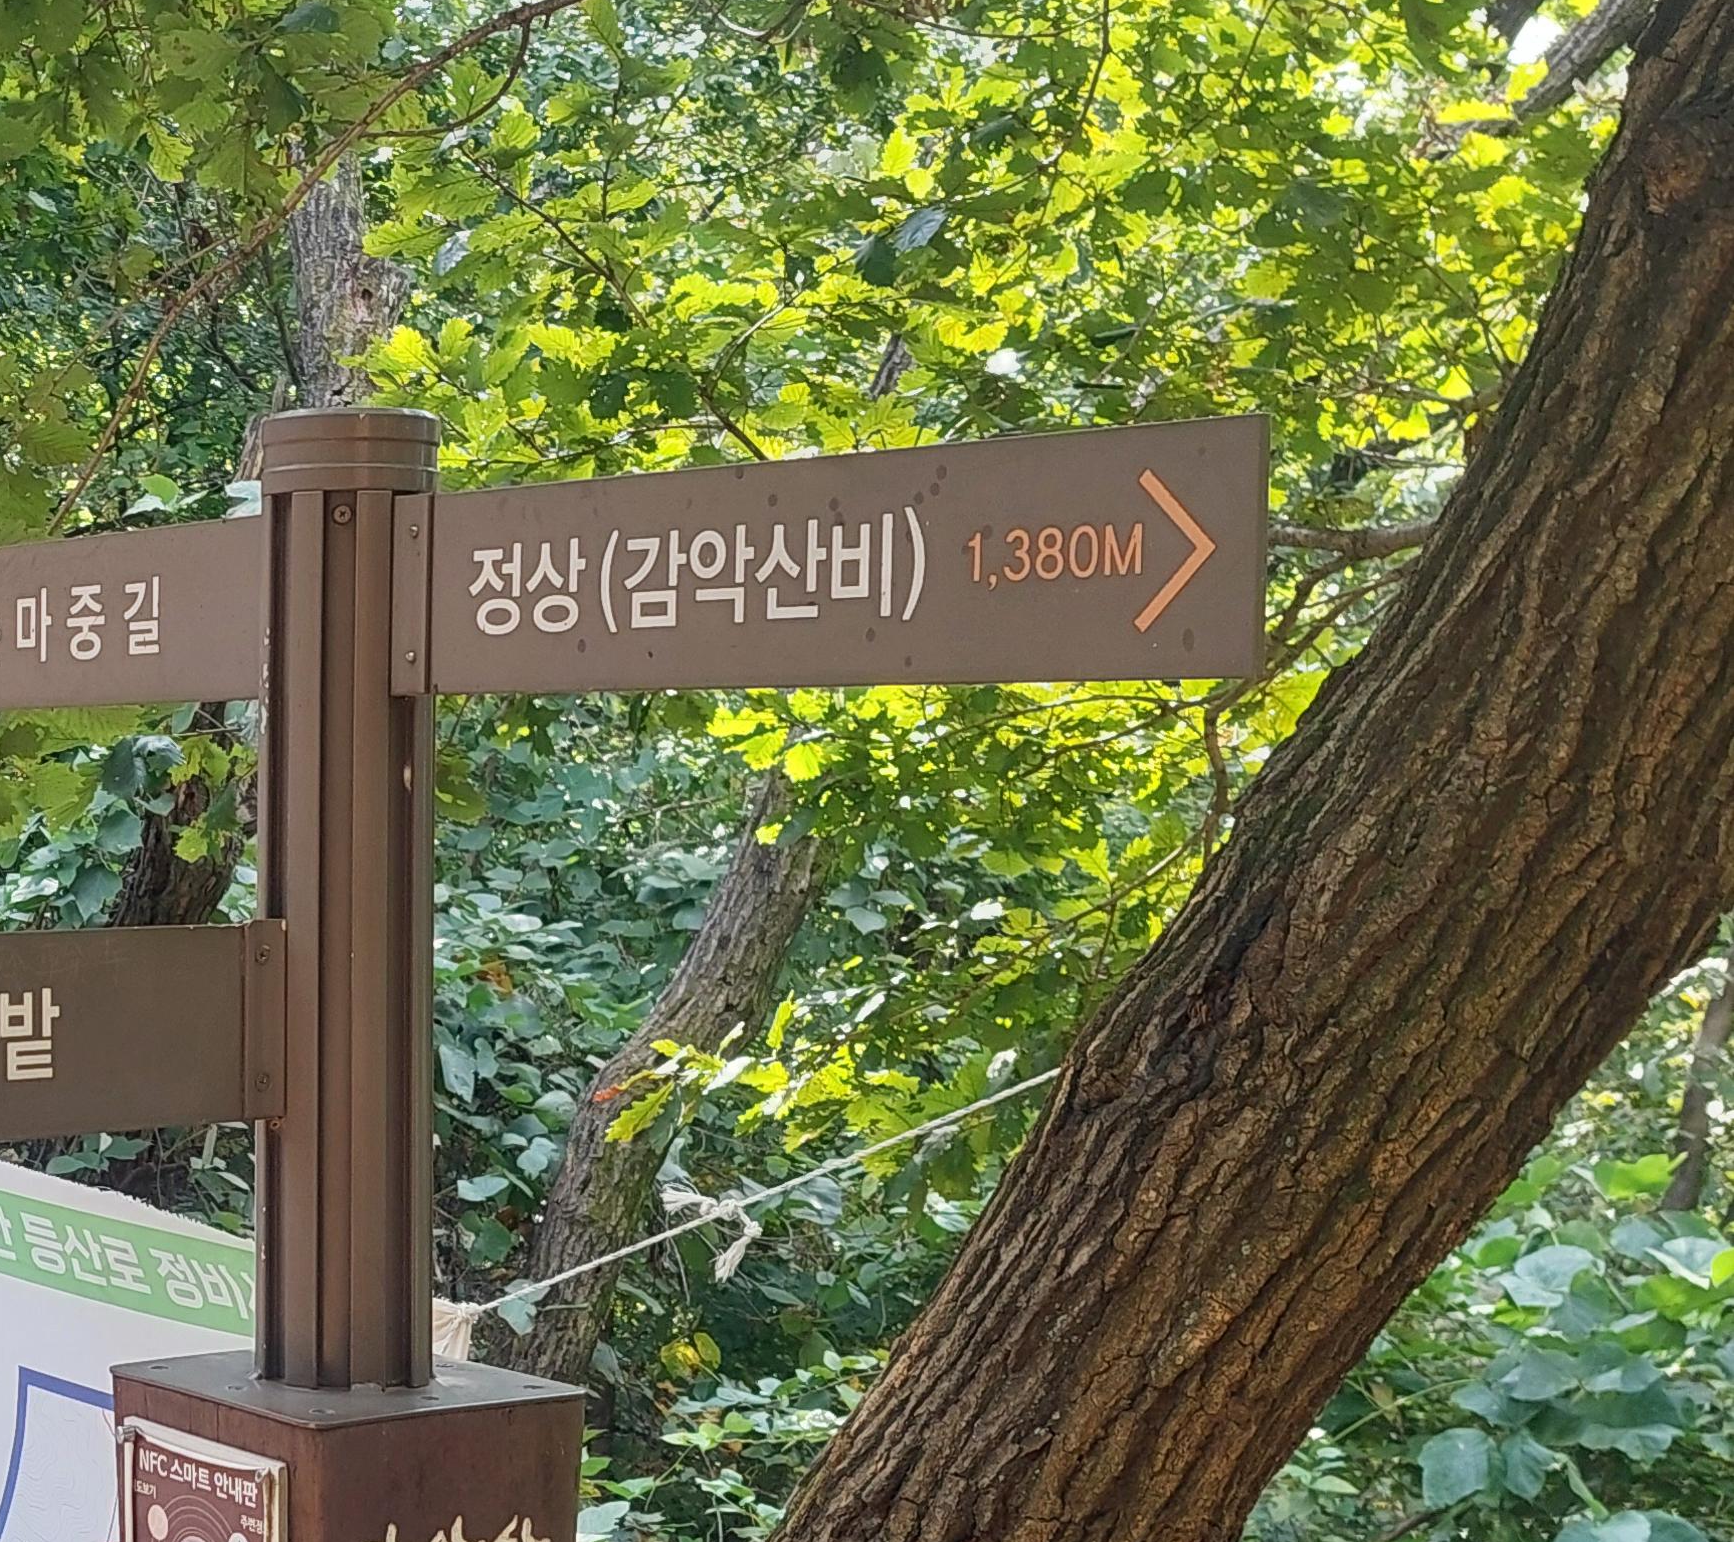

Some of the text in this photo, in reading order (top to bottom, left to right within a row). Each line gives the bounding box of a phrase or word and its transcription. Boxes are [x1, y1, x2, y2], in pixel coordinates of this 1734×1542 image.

[968, 523, 1144, 589] 1,380M
[19, 1209, 153, 1296] 등산로
[148, 1246, 254, 1320] 정비
[135, 1479, 156, 1500] 도보기
[139, 1447, 258, 1509] NFC 스마트 안내판
[239, 1514, 265, 1535] 주변정
